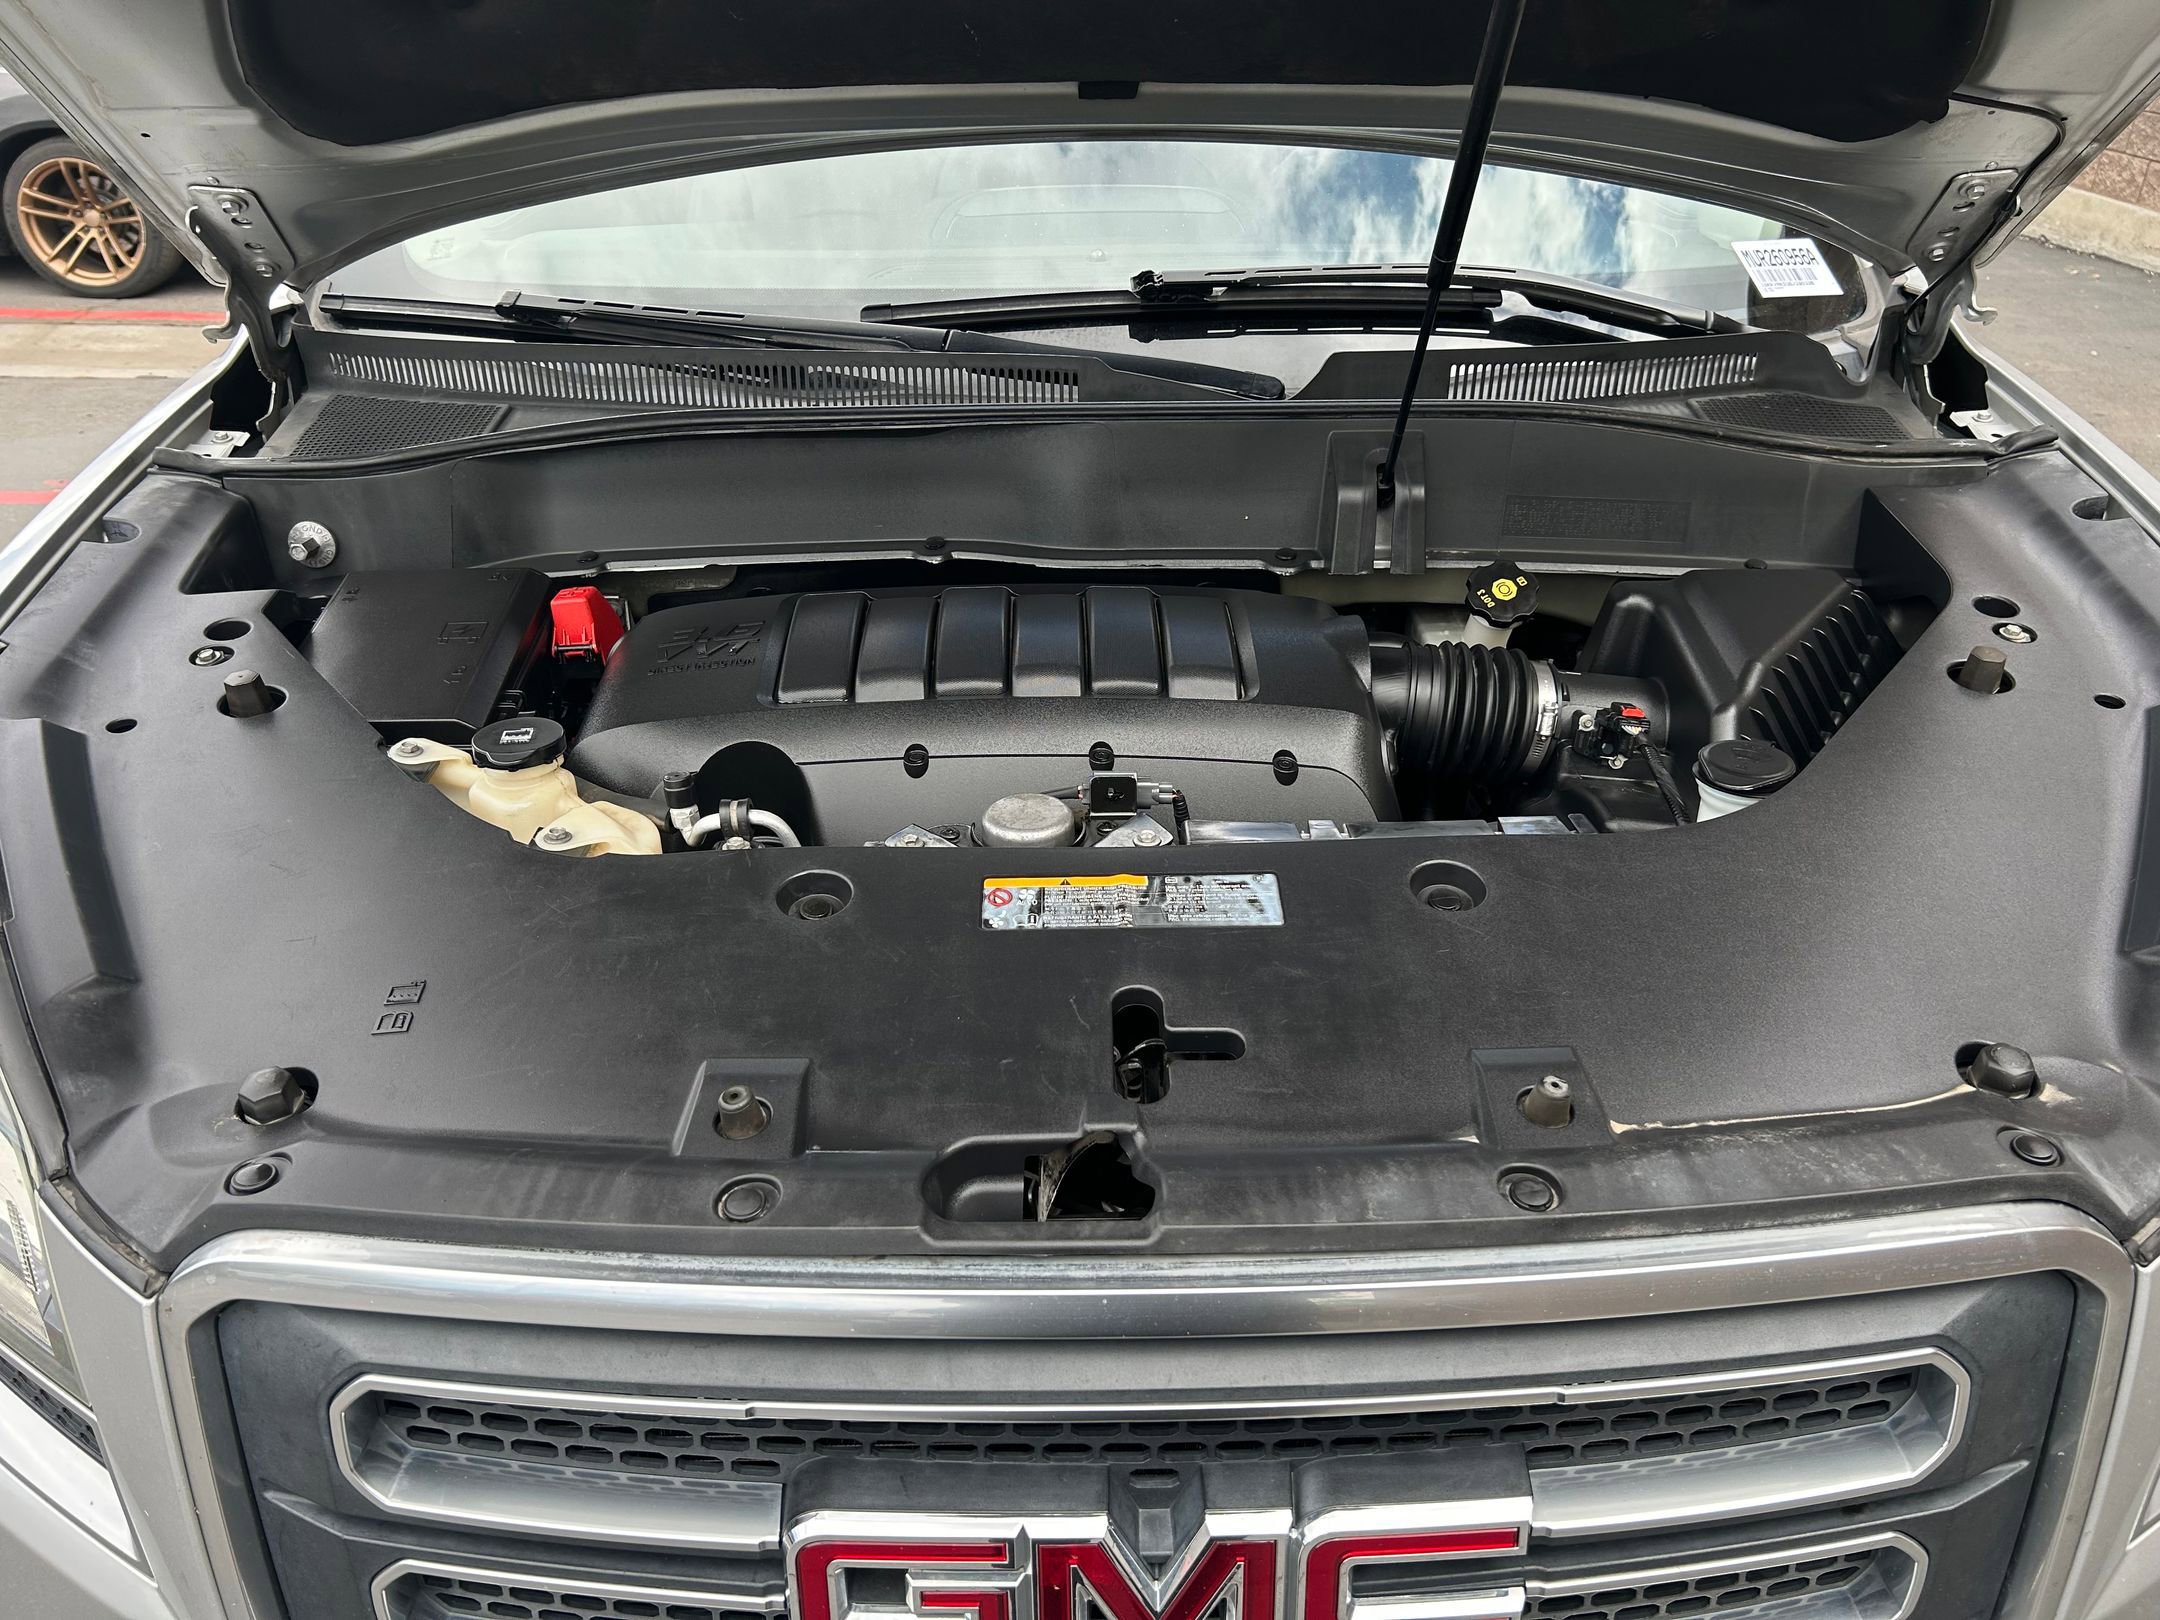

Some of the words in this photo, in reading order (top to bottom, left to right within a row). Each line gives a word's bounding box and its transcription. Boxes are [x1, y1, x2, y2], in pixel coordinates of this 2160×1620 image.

[1741, 247, 1820, 268] MUR260956A
[301, 524, 322, 535] GND
[782, 1497, 1534, 1620] GMC
